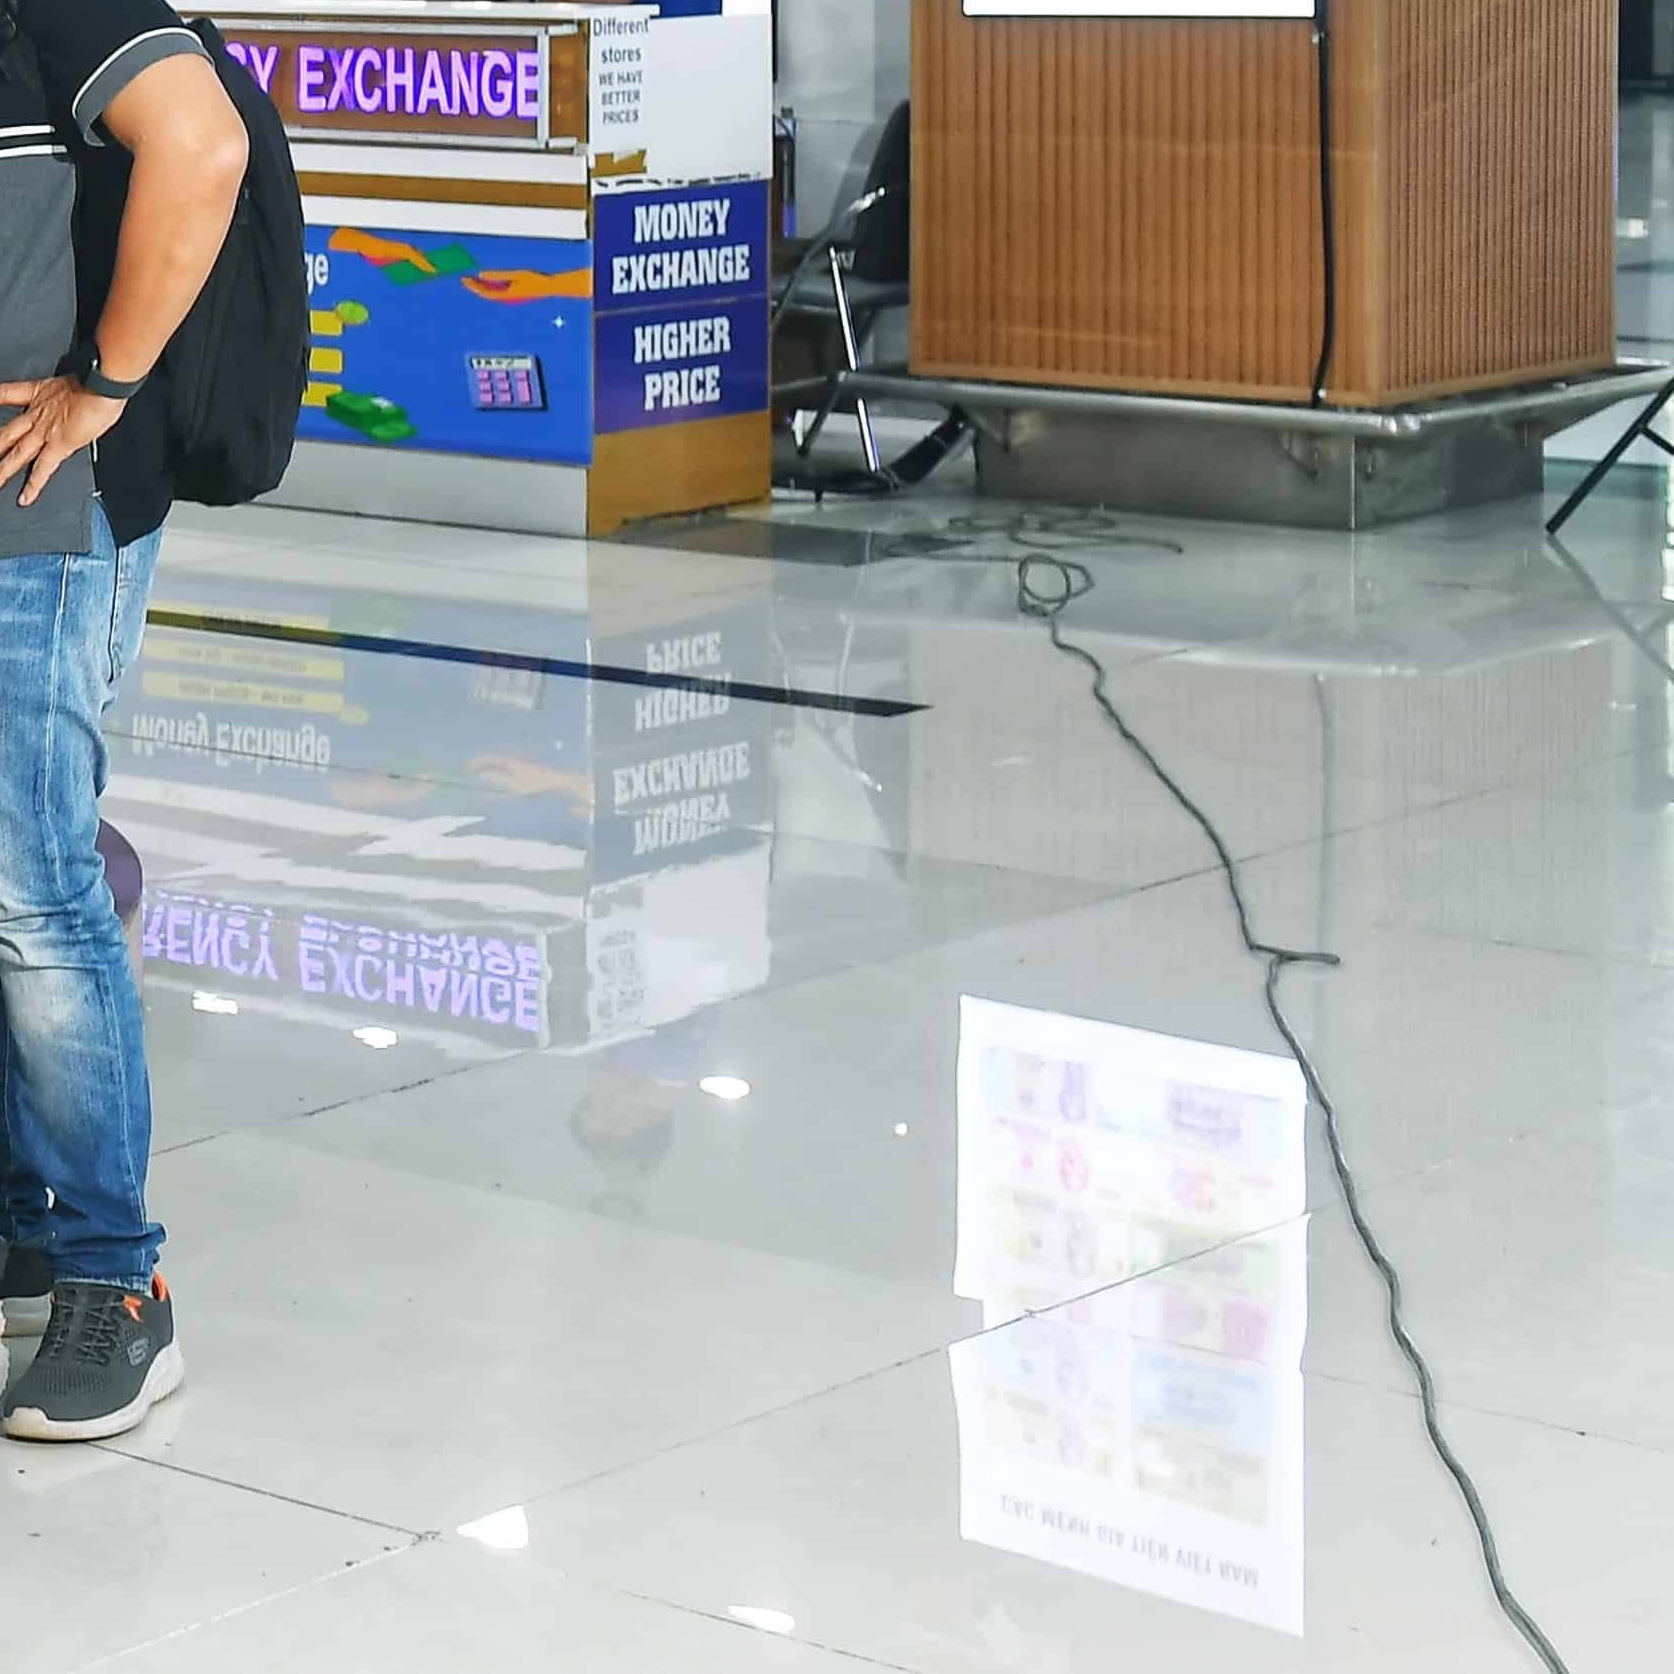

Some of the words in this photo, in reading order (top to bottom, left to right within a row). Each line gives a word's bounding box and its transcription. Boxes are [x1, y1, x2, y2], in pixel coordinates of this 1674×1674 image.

[593, 18, 649, 37] Different
[601, 46, 642, 64] stores
[297, 44, 539, 118] EXCHANGE
[599, 71, 613, 86] WE
[617, 69, 643, 85] HAVE
[601, 89, 641, 106] BETTER
[602, 109, 639, 125] PRICES
[634, 198, 731, 244] MONEY
[611, 244, 751, 295] EXCHANGE
[634, 316, 732, 365] HIGHER
[644, 365, 721, 412] PRICE
